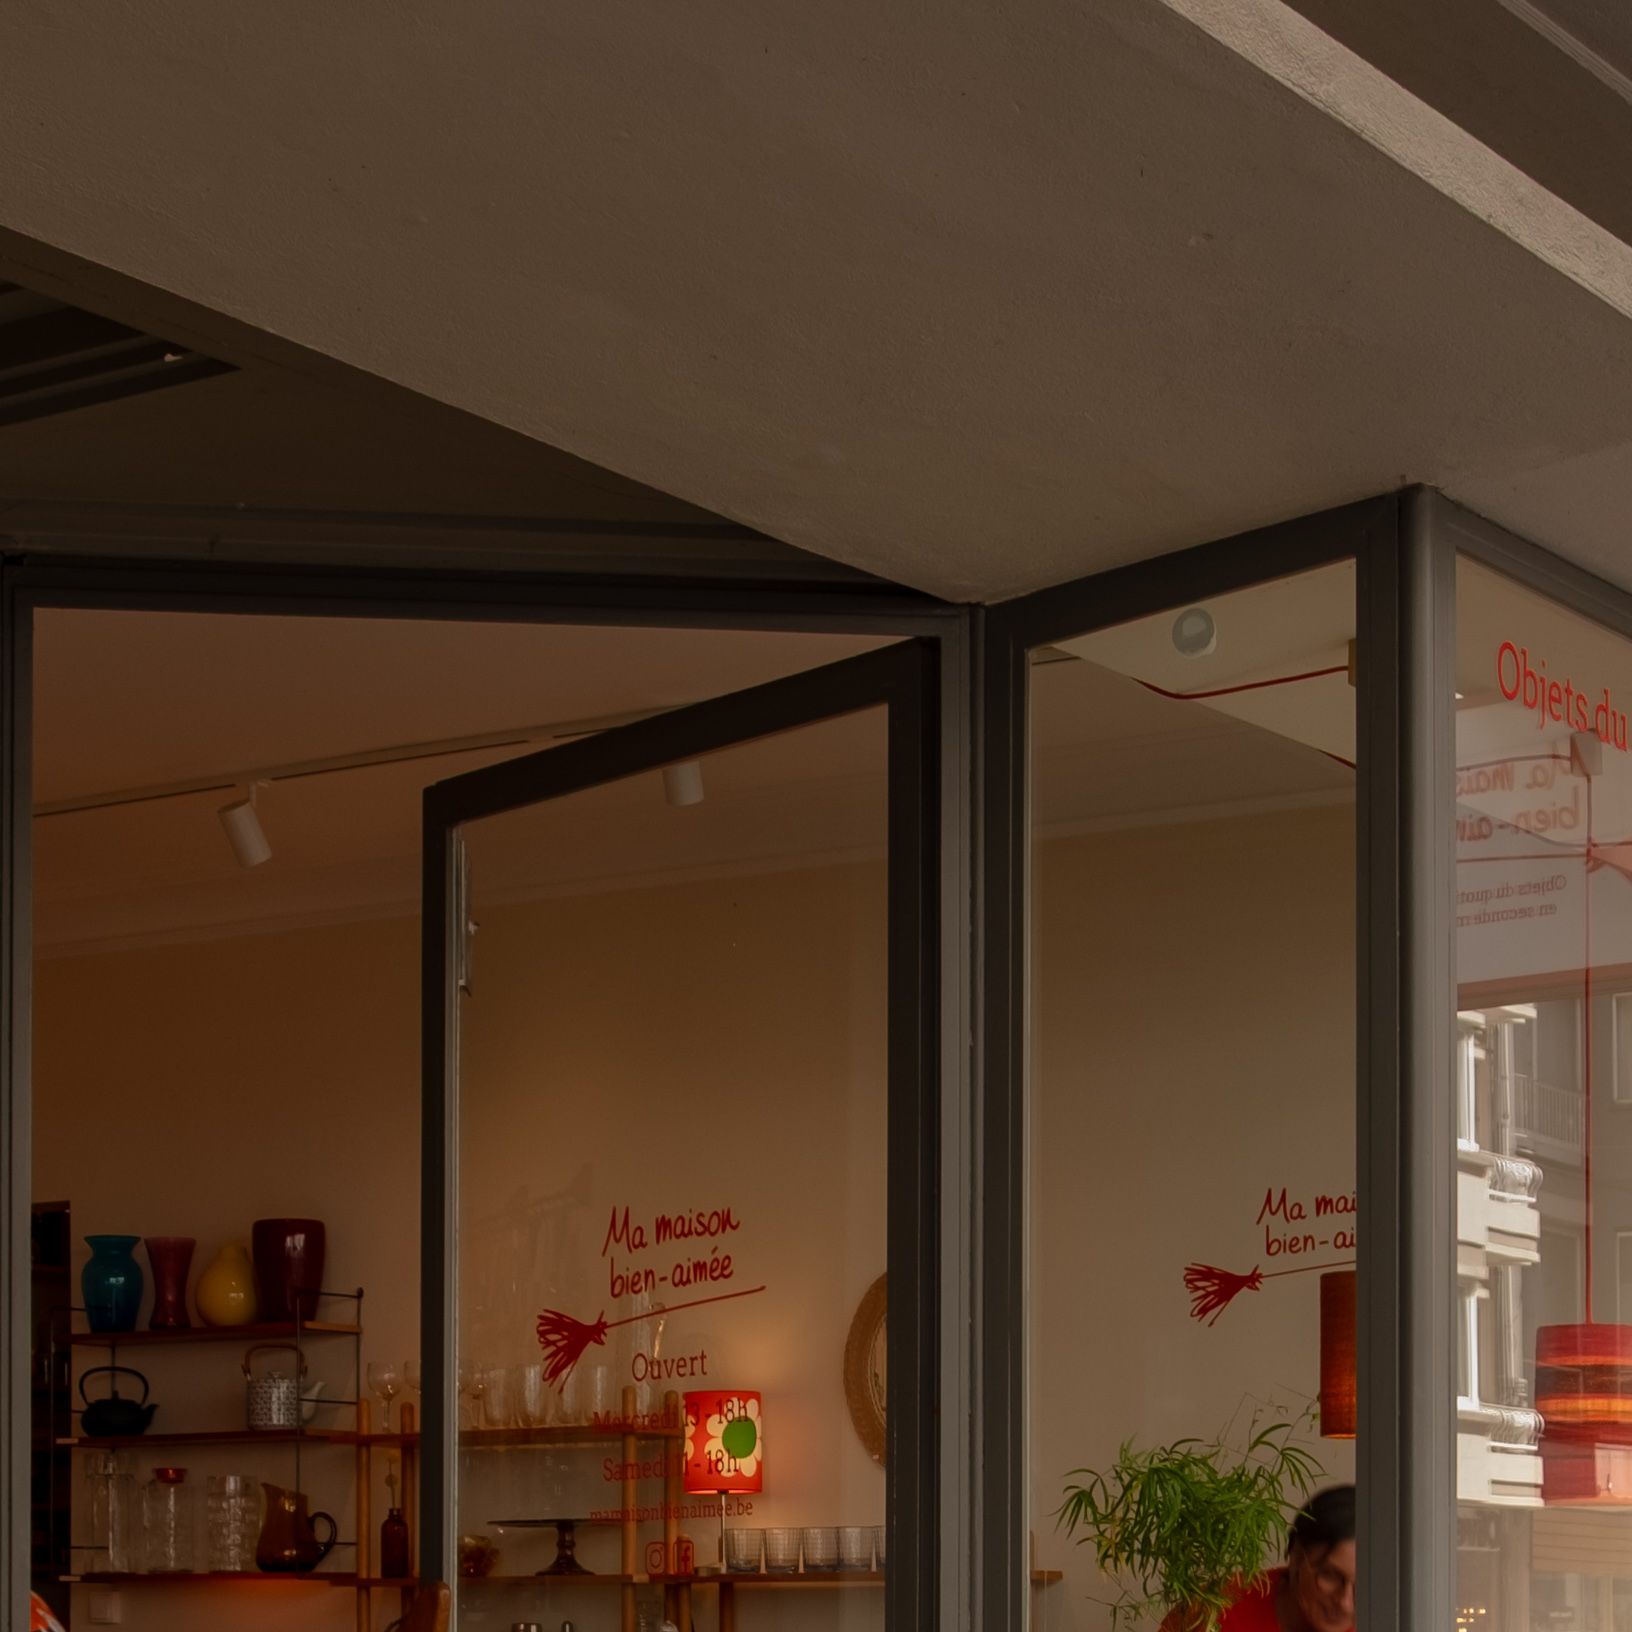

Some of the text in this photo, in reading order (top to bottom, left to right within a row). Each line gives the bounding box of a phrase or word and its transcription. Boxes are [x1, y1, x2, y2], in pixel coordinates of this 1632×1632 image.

[1497, 640, 1589, 731] Objets
[1594, 687, 1629, 752] du
[1256, 1187, 1357, 1225] Ma mai
[601, 1205, 741, 1257] Ma maison
[1265, 1225, 1357, 1256] bien-ai
[610, 1246, 734, 1299] bien-aimée
[631, 1350, 708, 1382] Ouvert
[716, 1398, 749, 1425] 18h
[707, 1449, 739, 1475] 18h
